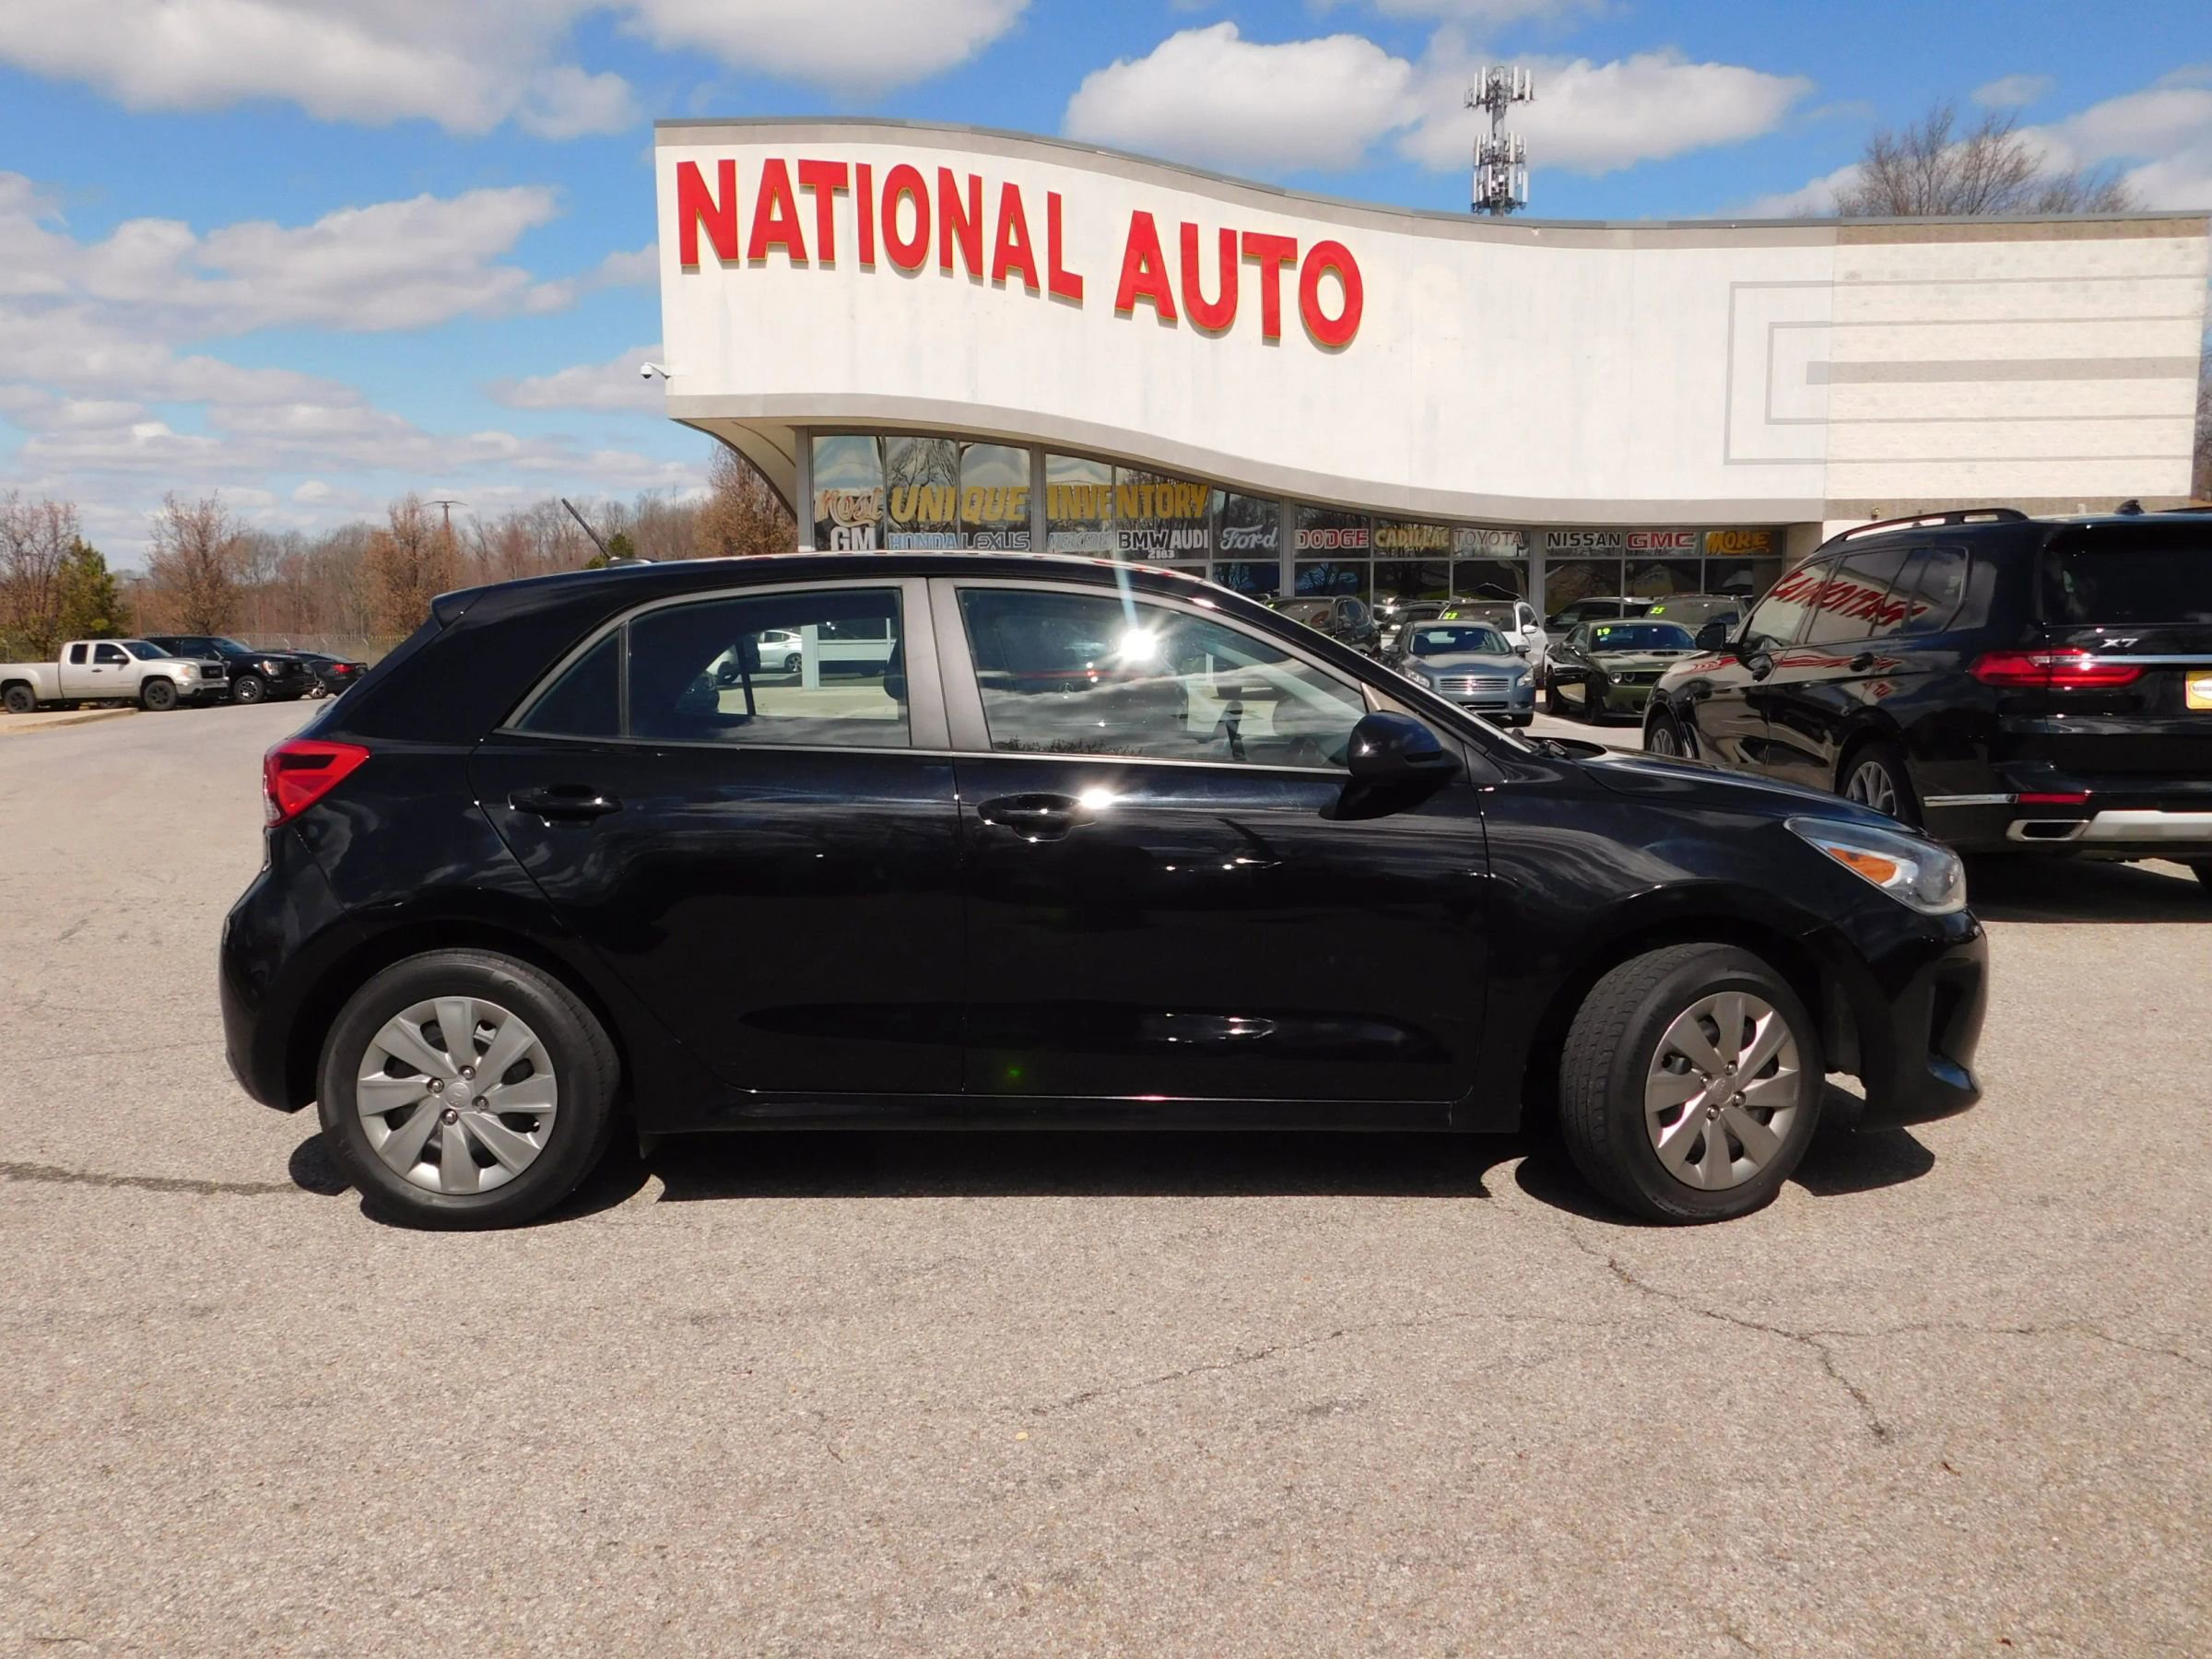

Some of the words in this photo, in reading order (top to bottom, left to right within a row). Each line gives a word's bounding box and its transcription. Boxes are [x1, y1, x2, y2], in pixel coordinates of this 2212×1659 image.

[677, 158, 1083, 301] NATIONAL
[1114, 210, 1363, 347] AUTO
[890, 485, 1030, 524] UNIQUE
[1045, 483, 1209, 520] INVENTORY
[830, 526, 876, 550] GM
[888, 531, 959, 550] HONDA
[960, 532, 1031, 551] LEXUS
[1117, 529, 1169, 551] BMW
[1170, 529, 1209, 549] AUDI
[1219, 524, 1277, 550] Ford
[1293, 528, 1370, 550] DODGE
[1374, 526, 1451, 549] CADILLAC
[1453, 528, 1524, 547] TOYOTA
[1546, 531, 1621, 549] NISSAN
[1625, 531, 1698, 550] GMC
[1706, 530, 1771, 554] MORE
[2100, 638, 2139, 649] X7
